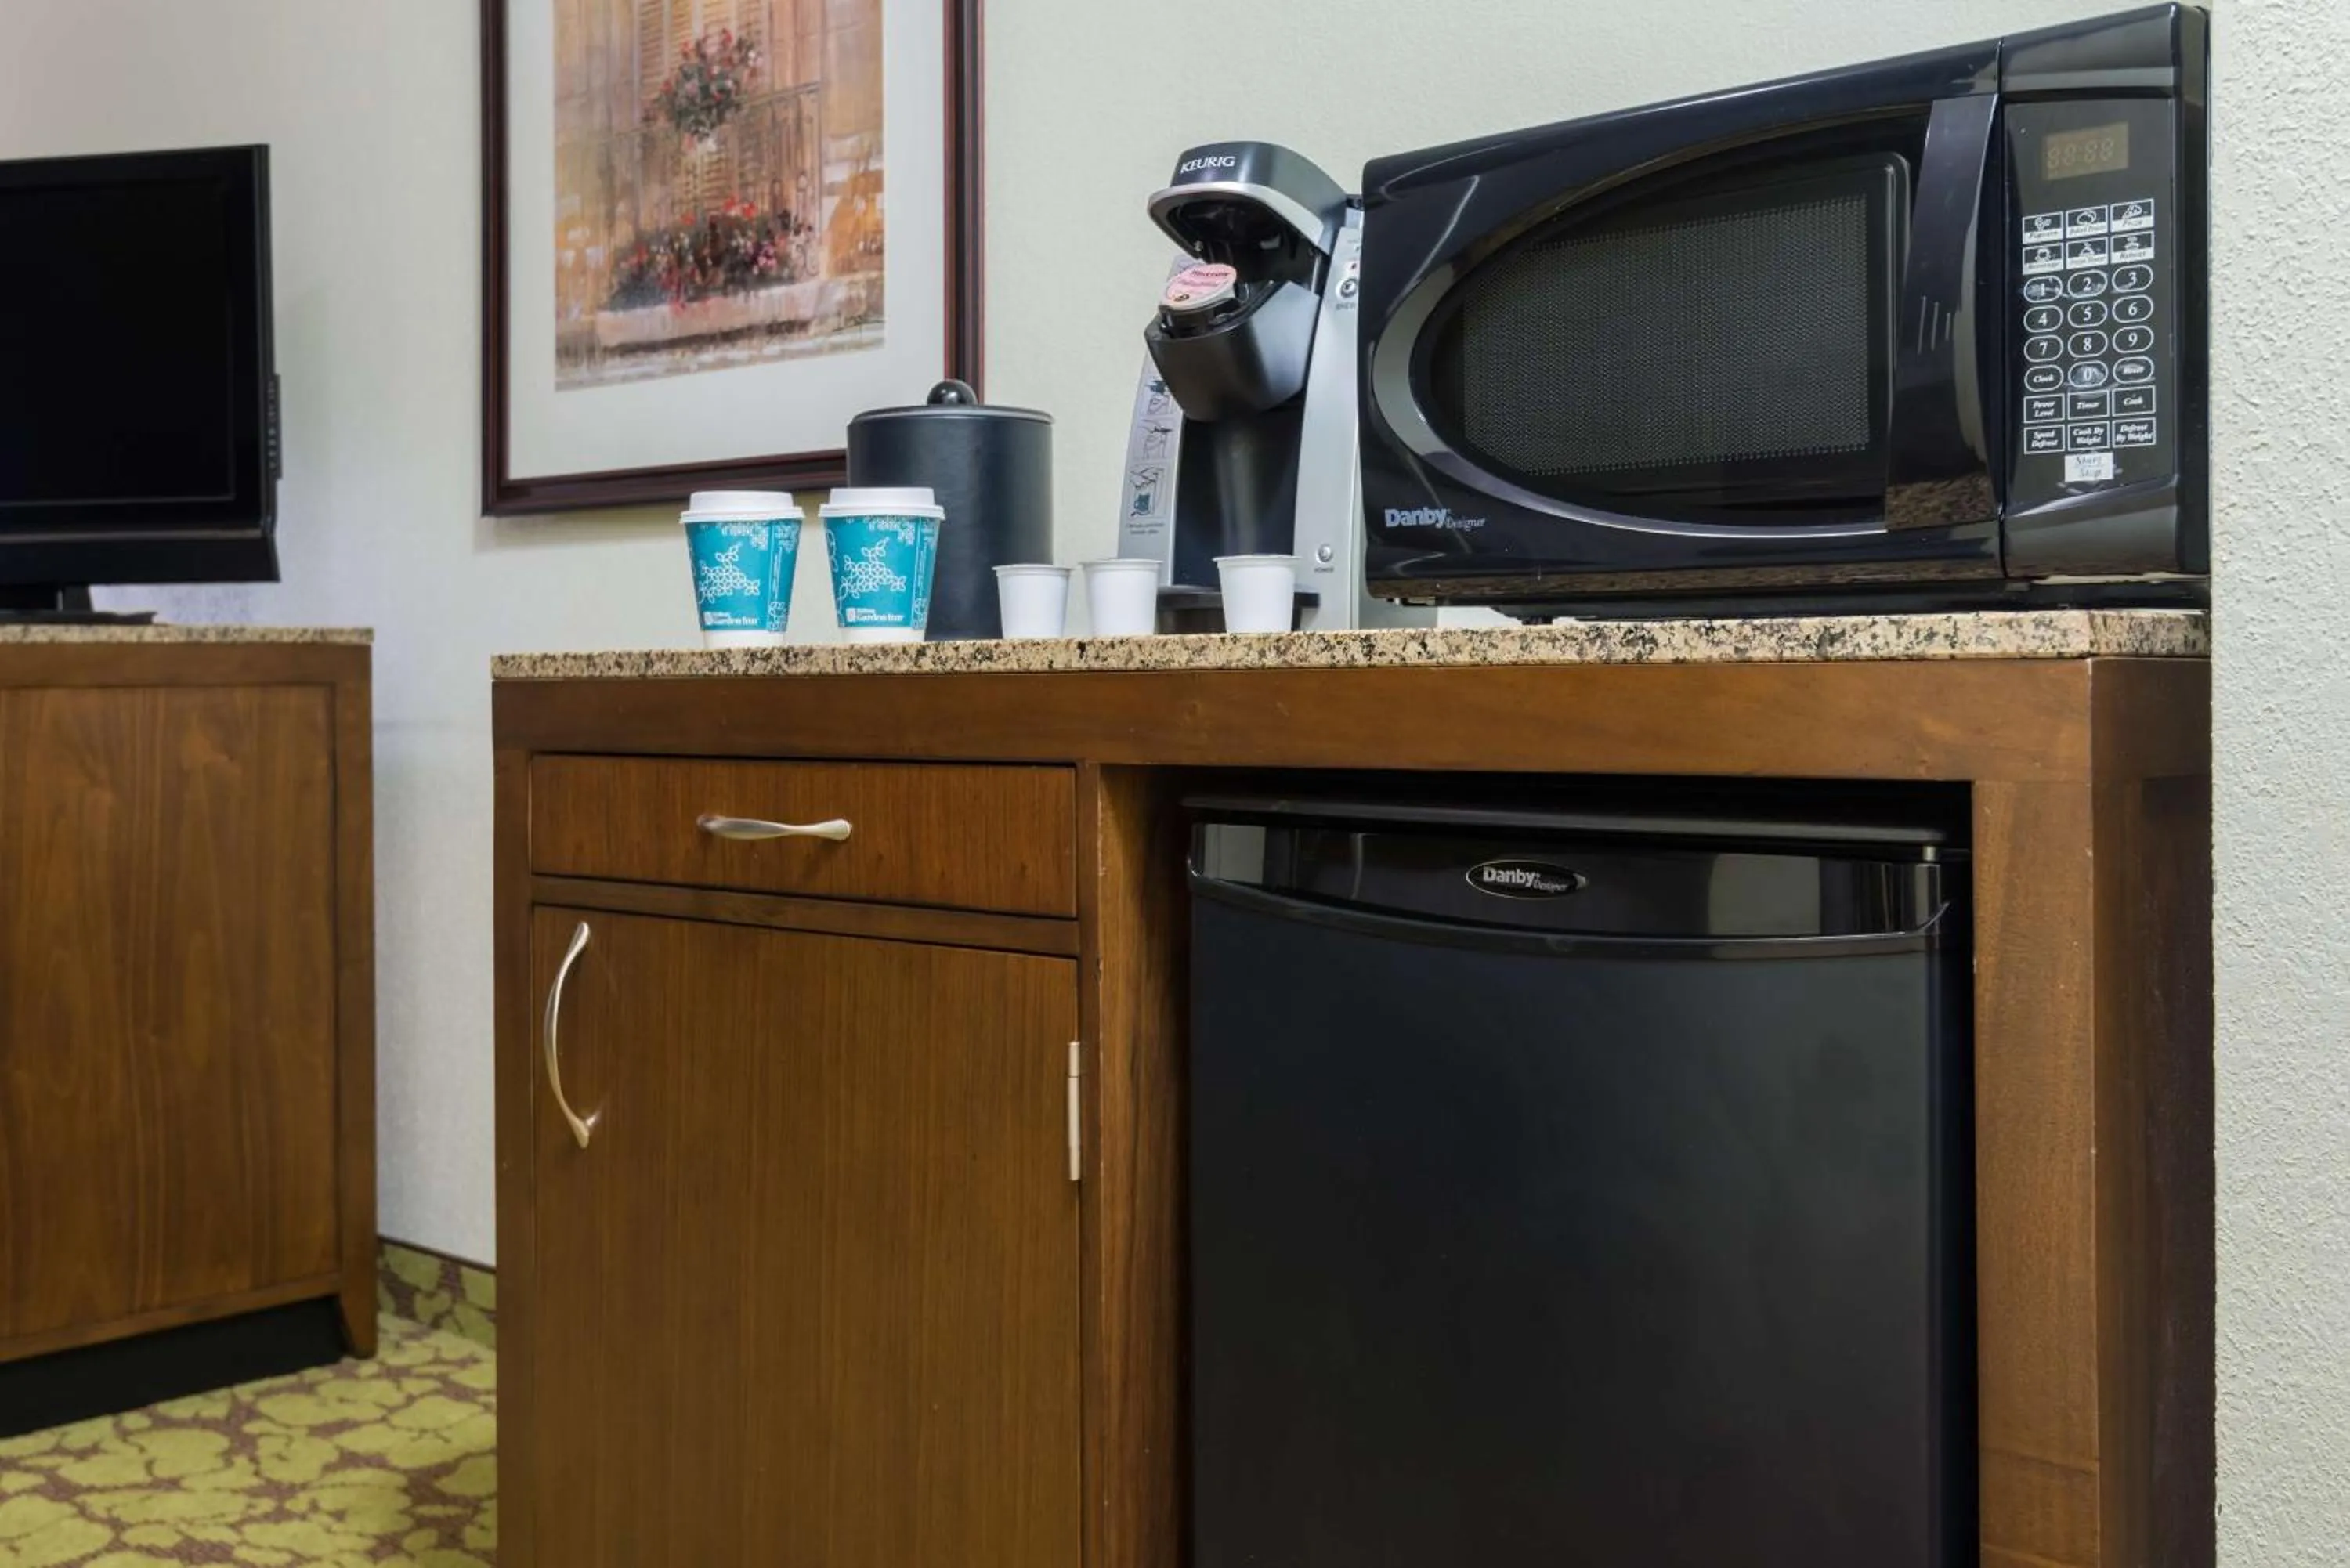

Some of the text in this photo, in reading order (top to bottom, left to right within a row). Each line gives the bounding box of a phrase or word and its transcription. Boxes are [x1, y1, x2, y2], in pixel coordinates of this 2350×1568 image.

[1180, 156, 1235, 173] KEURIG
[2083, 276, 2092, 291] 2
[2128, 271, 2138, 285] 3
[2083, 306, 2092, 321] 5
[2128, 302, 2138, 316] 6
[2038, 312, 2048, 326] 4
[2083, 337, 2092, 352] 8
[2128, 332, 2138, 347] 9
[2039, 341, 2048, 355] 7
[2083, 367, 2092, 381] 0
[1384, 507, 1446, 529] Danby
[1483, 866, 1535, 887] Danby
